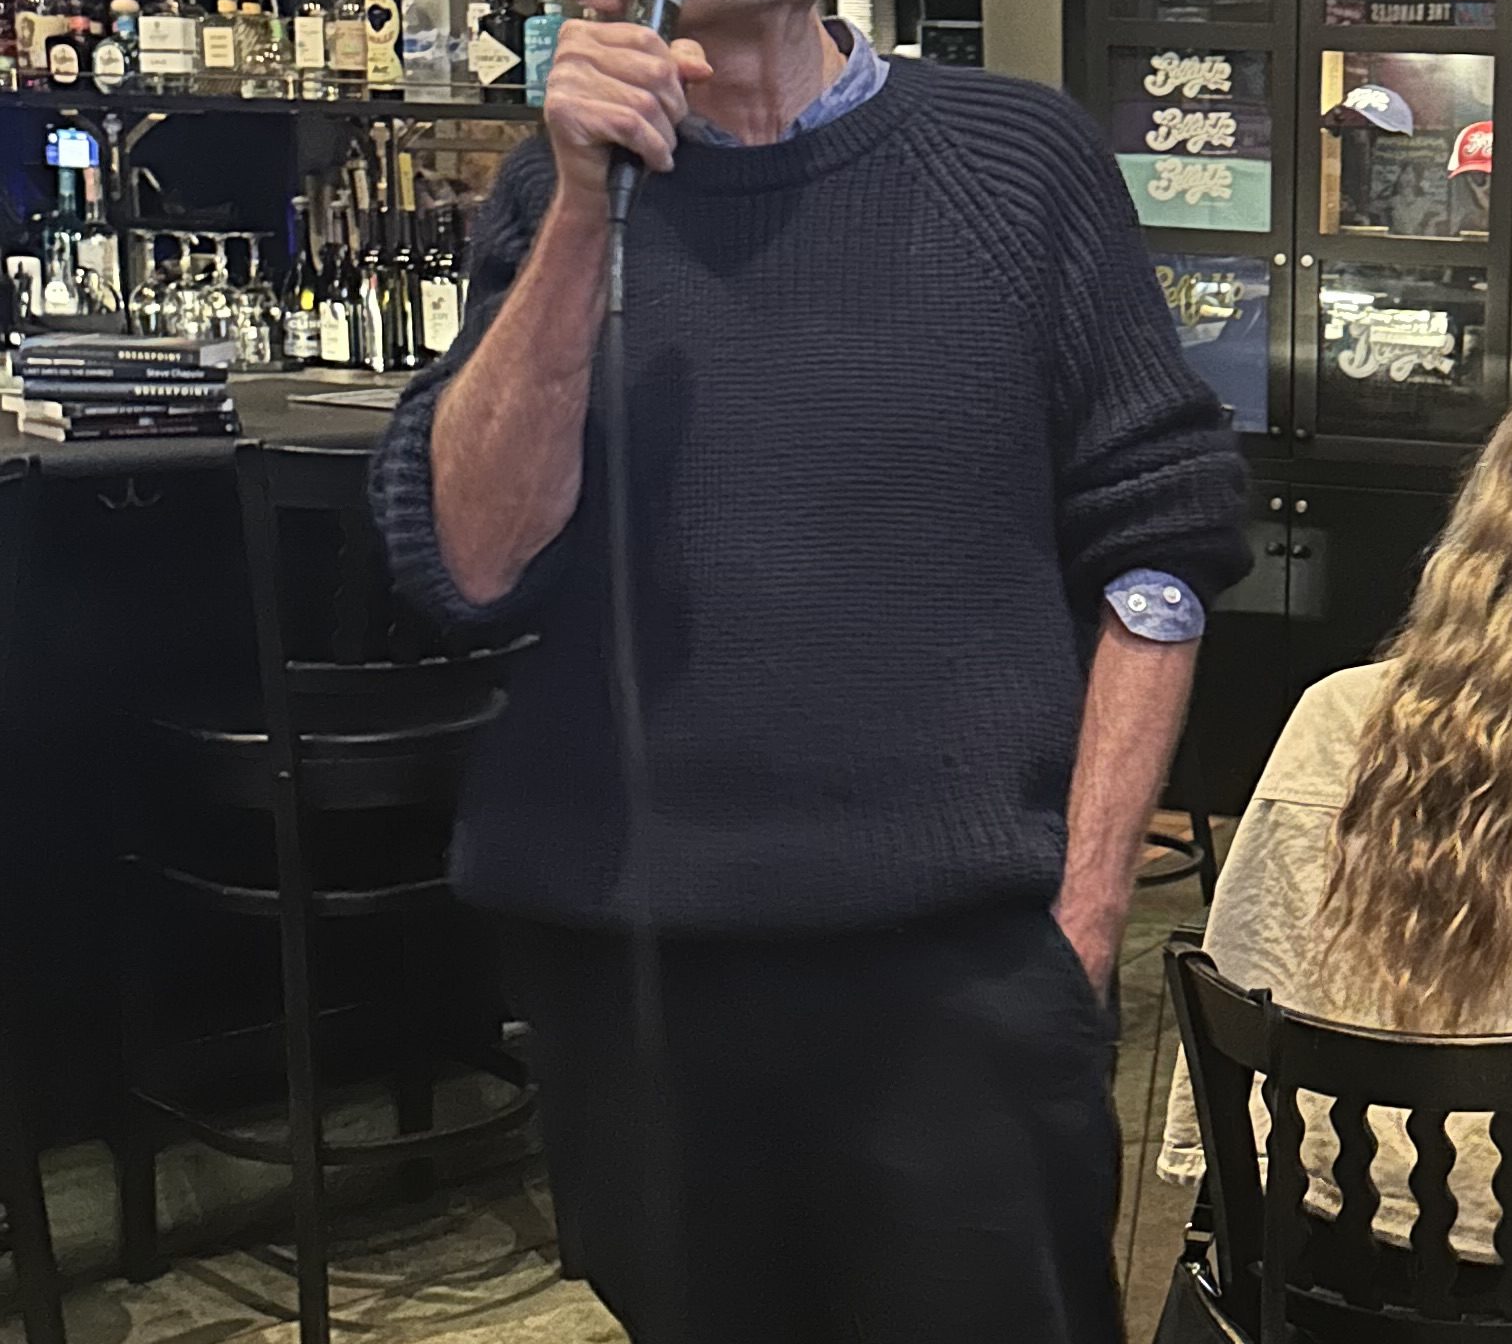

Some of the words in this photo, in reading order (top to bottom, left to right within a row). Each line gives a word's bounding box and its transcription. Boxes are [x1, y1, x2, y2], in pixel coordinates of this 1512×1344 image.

[118, 350, 181, 362] BREAKPOINT
[146, 367, 170, 378] Steve
[134, 386, 209, 396] BREAKPOINT
